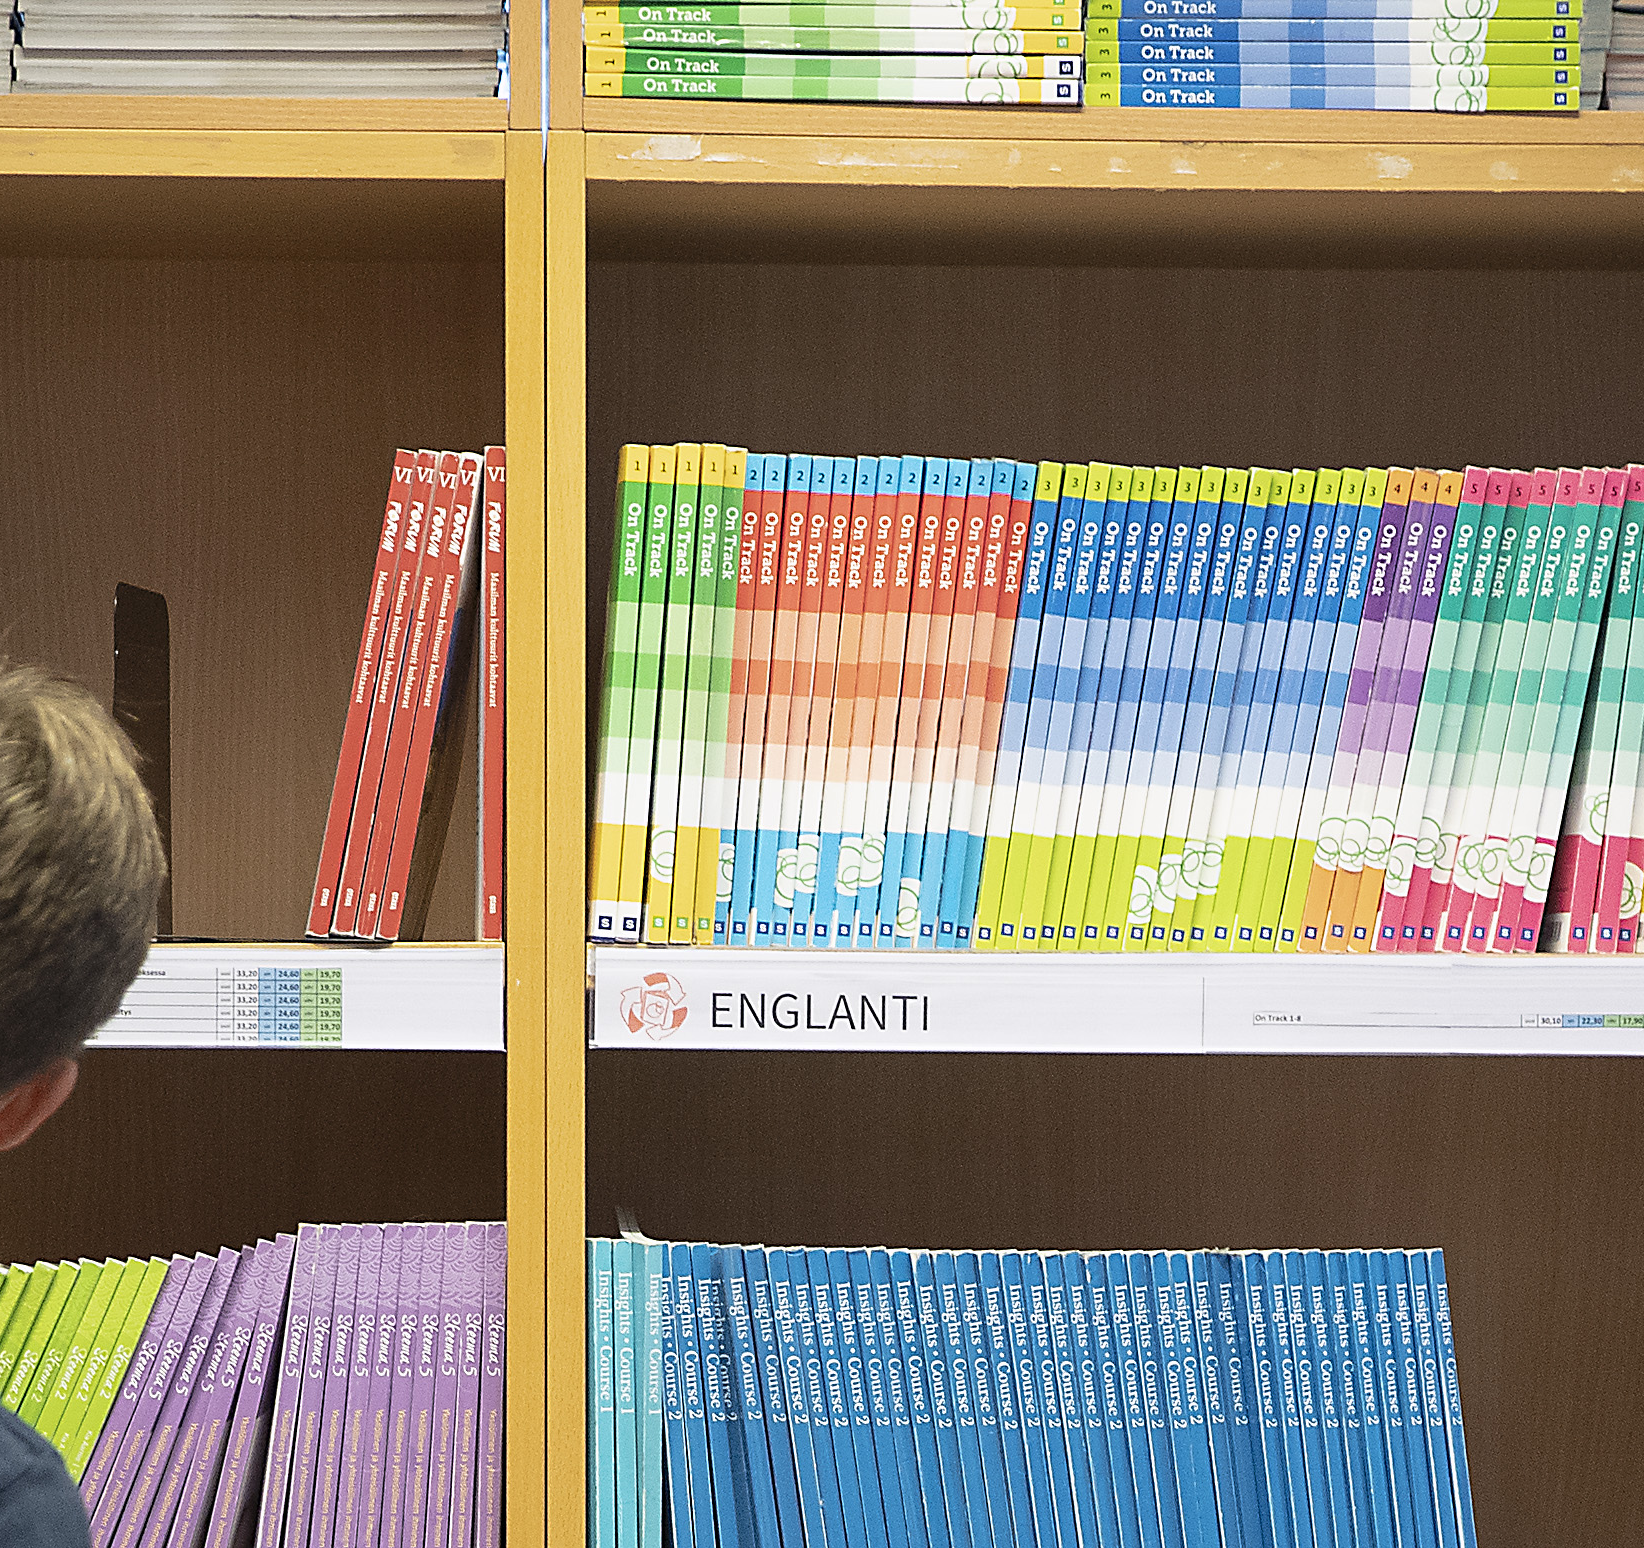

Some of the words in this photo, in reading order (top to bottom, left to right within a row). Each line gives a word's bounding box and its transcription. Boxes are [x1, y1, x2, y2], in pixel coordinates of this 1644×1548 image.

[639, 7, 662, 21] On
[666, 8, 711, 22] Track
[1140, 24, 1164, 37] On
[1168, 24, 1212, 38] Track
[644, 79, 667, 92] On
[671, 79, 716, 93] Track
[1142, 90, 1166, 103] On
[1170, 90, 1215, 104] Track
[394, 467, 412, 484] VI
[488, 467, 505, 482] VI
[635, 461, 640, 471] 1
[797, 471, 804, 481] 2
[1045, 481, 1051, 490] 3
[1394, 485, 1401, 493] 4
[1471, 484, 1477, 494] 5
[627, 503, 641, 527] On
[790, 513, 804, 536] On
[1034, 522, 1048, 546] On
[1380, 525, 1396, 548] On
[1457, 525, 1473, 548] On
[624, 531, 640, 576] Track
[786, 541, 801, 585] Track
[1027, 550, 1045, 594] Track
[1372, 552, 1392, 596] Track
[1448, 553, 1468, 596] Track
[372, 571, 388, 615] Maailman
[490, 572, 499, 617] Maailman
[356, 661, 372, 703] kohtaavat
[237, 970, 257, 978] 33,20
[320, 971, 340, 979] 19,70
[712, 992, 928, 1031] ENGLANTI
[1255, 1014, 1266, 1022] On
[1268, 1014, 1288, 1022] Track
[1541, 1017, 1561, 1025] 30,10
[1581, 1017, 1602, 1025] 22,30
[594, 1270, 613, 1332] Insights
[676, 1275, 695, 1338] Insights
[334, 1314, 353, 1363] Skeema
[489, 1313, 504, 1364] Skeema
[1415, 1284, 1431, 1345] Insights
[1424, 1359, 1438, 1413] Course
[1431, 1417, 1443, 1427] 2
[60, 1346, 87, 1389] Skeema
[332, 1366, 346, 1377] 5
[487, 1366, 501, 1377] 5
[599, 1346, 613, 1400] Course
[684, 1351, 700, 1406] Course
[55, 1388, 66, 1400] 2
[689, 1410, 703, 1419] 2
